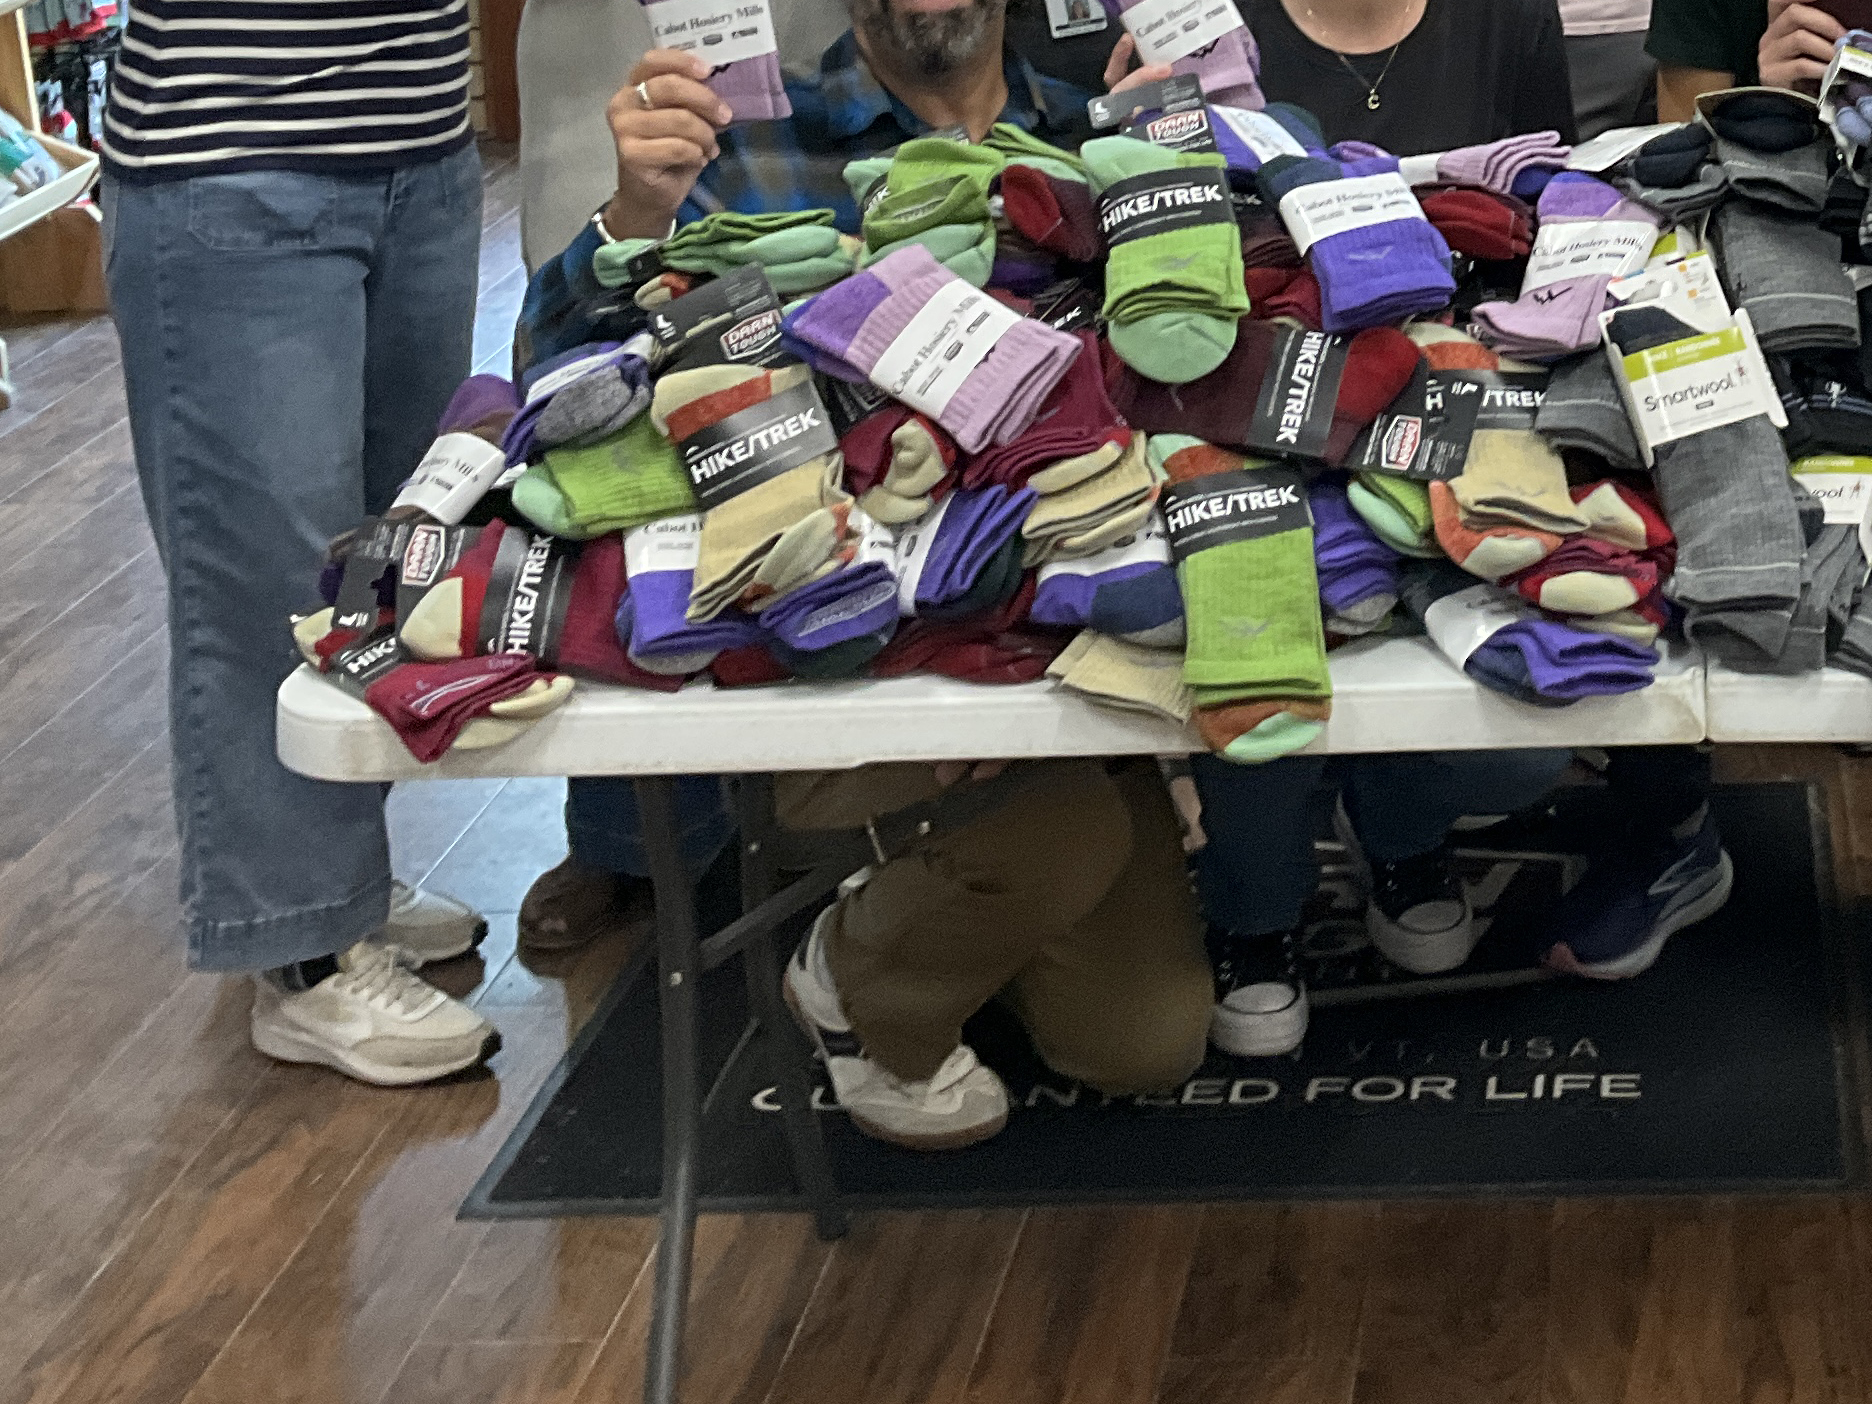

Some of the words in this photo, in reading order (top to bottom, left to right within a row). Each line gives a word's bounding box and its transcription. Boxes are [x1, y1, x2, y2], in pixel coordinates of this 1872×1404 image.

[1102, 183, 1224, 233] HIKE/TREK
[1275, 330, 1325, 445] HIKE/TREK
[1643, 372, 1735, 415] Smartwool
[689, 407, 822, 485] HIKE/TREK
[1167, 483, 1301, 533] HIKE/TREK
[505, 533, 554, 657] HIKE/TREK
[1479, 1036, 1600, 1060] USA
[1306, 1075, 1458, 1103] FOR
[1484, 1072, 1643, 1101] LIFE
